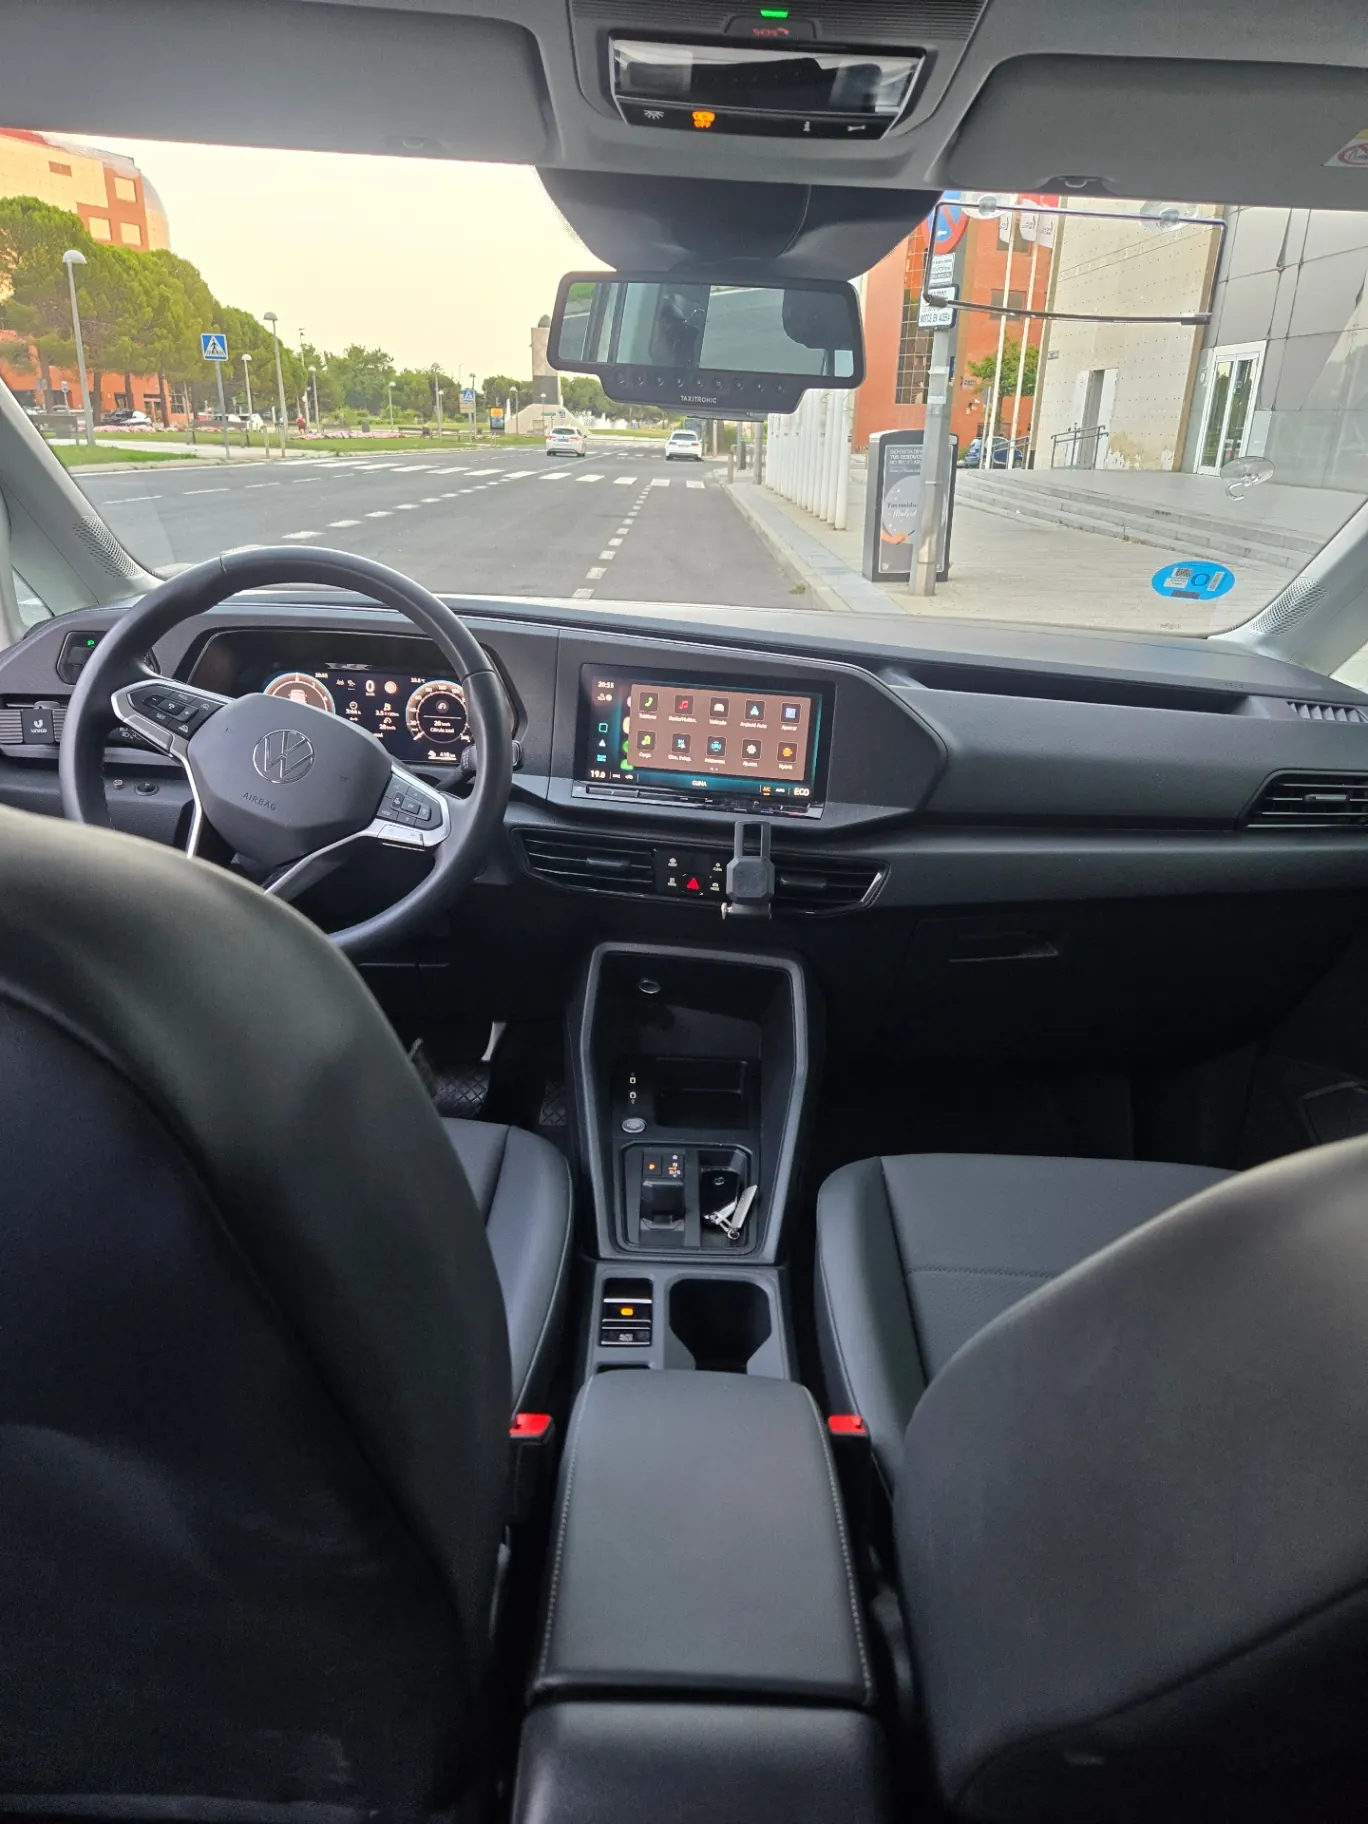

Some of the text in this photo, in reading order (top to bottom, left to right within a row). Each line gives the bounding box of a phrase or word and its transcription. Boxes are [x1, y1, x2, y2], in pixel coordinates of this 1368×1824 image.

[680, 395, 717, 404] TAXITRONIC
[365, 679, 375, 693] 0
[591, 770, 606, 778] 19.0
[793, 787, 810, 797] ECO
[243, 792, 276, 811] AIRBAG
